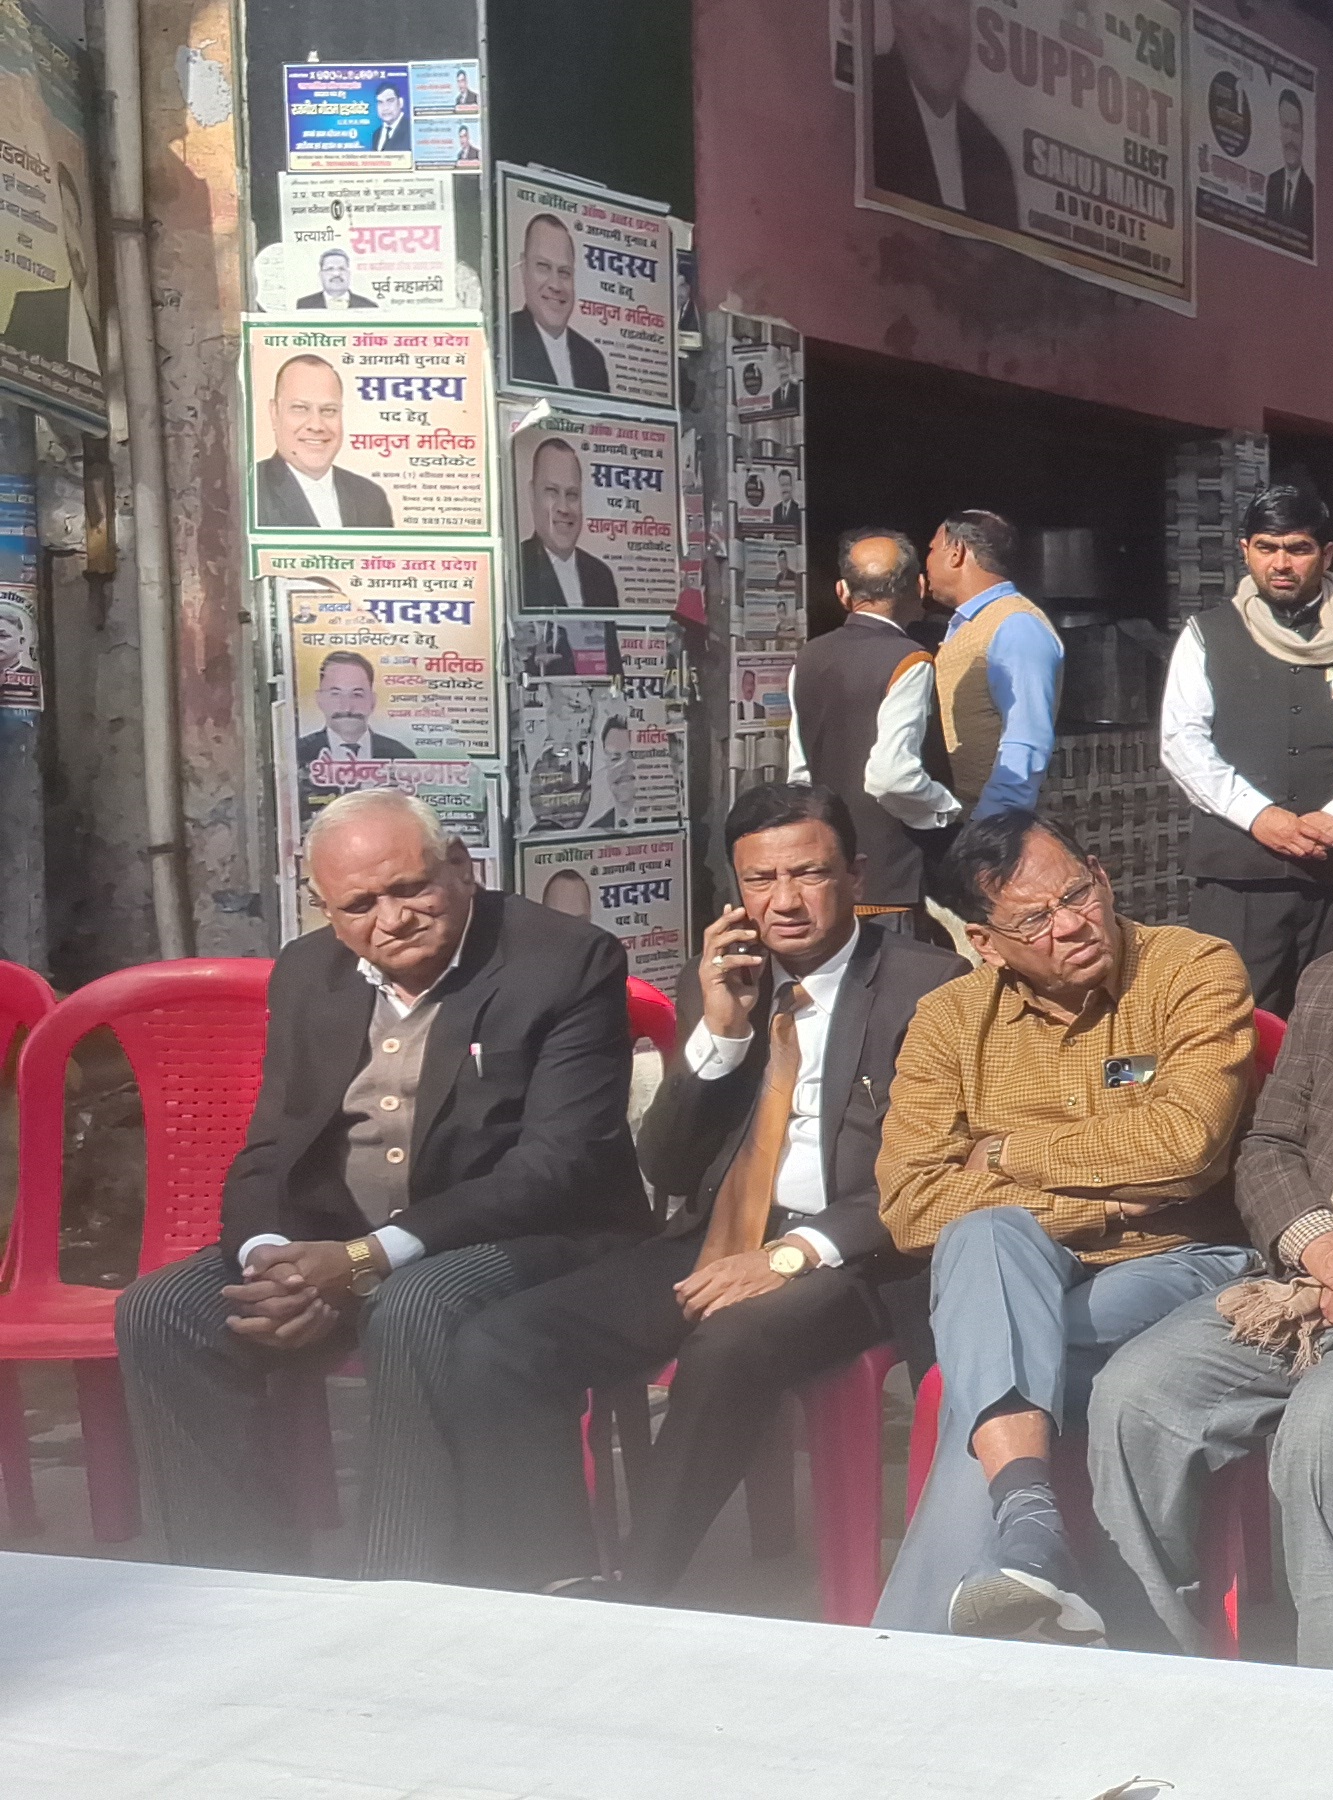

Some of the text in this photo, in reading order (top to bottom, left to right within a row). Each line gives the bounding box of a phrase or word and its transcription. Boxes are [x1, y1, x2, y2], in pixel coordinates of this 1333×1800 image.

[976, 6, 1174, 146] SUPPORT
[1123, 137, 1168, 180] ELECT
[1032, 137, 1101, 196] SANUJ
[1106, 167, 1168, 223] MALIK
[1054, 191, 1147, 241] ADVOCATE
[349, 225, 442, 254] सदस्य
[583, 243, 658, 282] सदस्य
[371, 275, 443, 299] पूर्व महामंत्री
[625, 305, 664, 328] मलिक
[353, 332, 387, 347] ऑफ
[393, 335, 427, 347] उत्तर
[433, 332, 470, 348] प्रदेश
[341, 352, 467, 369] के आगामी चुनाव में
[355, 376, 467, 401] सदस्य
[379, 411, 401, 422] पद
[349, 428, 477, 457] सानुज मलिक
[409, 455, 476, 467] एडवोकेट
[590, 462, 664, 492] सदस्य
[360, 556, 396, 570] ऑफ
[402, 559, 436, 571] उत्तर
[441, 557, 477, 571] प्रदेश
[350, 575, 475, 592] के आगामी चुनाव में
[363, 600, 475, 625] सदस्य
[424, 651, 485, 673] मलिक
[599, 878, 673, 909] सदस्य
